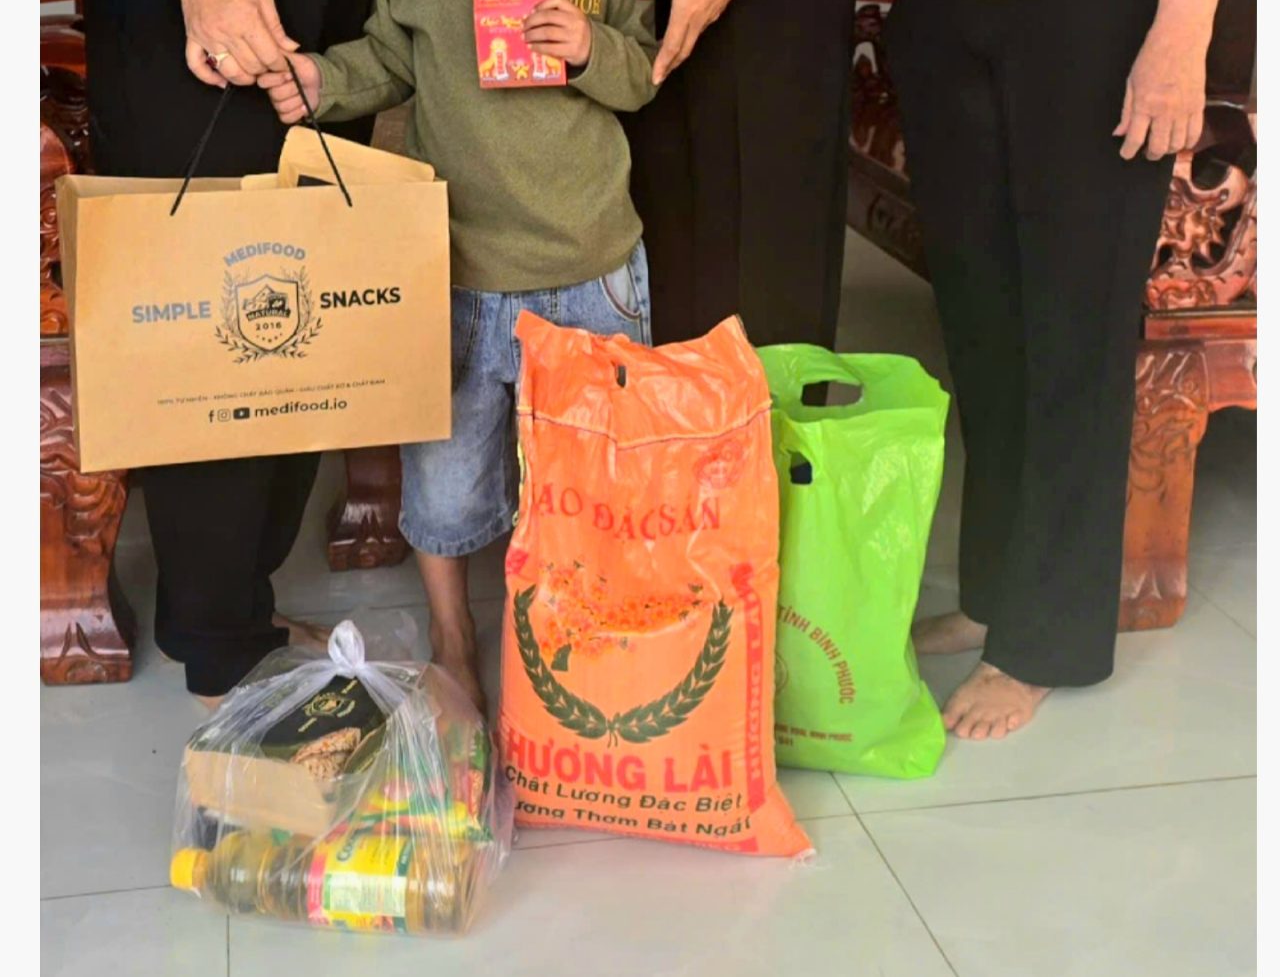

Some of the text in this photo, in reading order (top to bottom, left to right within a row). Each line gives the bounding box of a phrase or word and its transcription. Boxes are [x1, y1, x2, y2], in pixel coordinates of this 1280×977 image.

[223, 242, 306, 267] MEDIFOOD
[320, 287, 401, 310] SNACKS
[132, 300, 211, 324] SIMPLE
[254, 398, 348, 419] medifood.io
[507, 733, 733, 794] HƯƠNG LÀI
[695, 792, 743, 817] Biệt
[572, 808, 639, 828] Thơm
